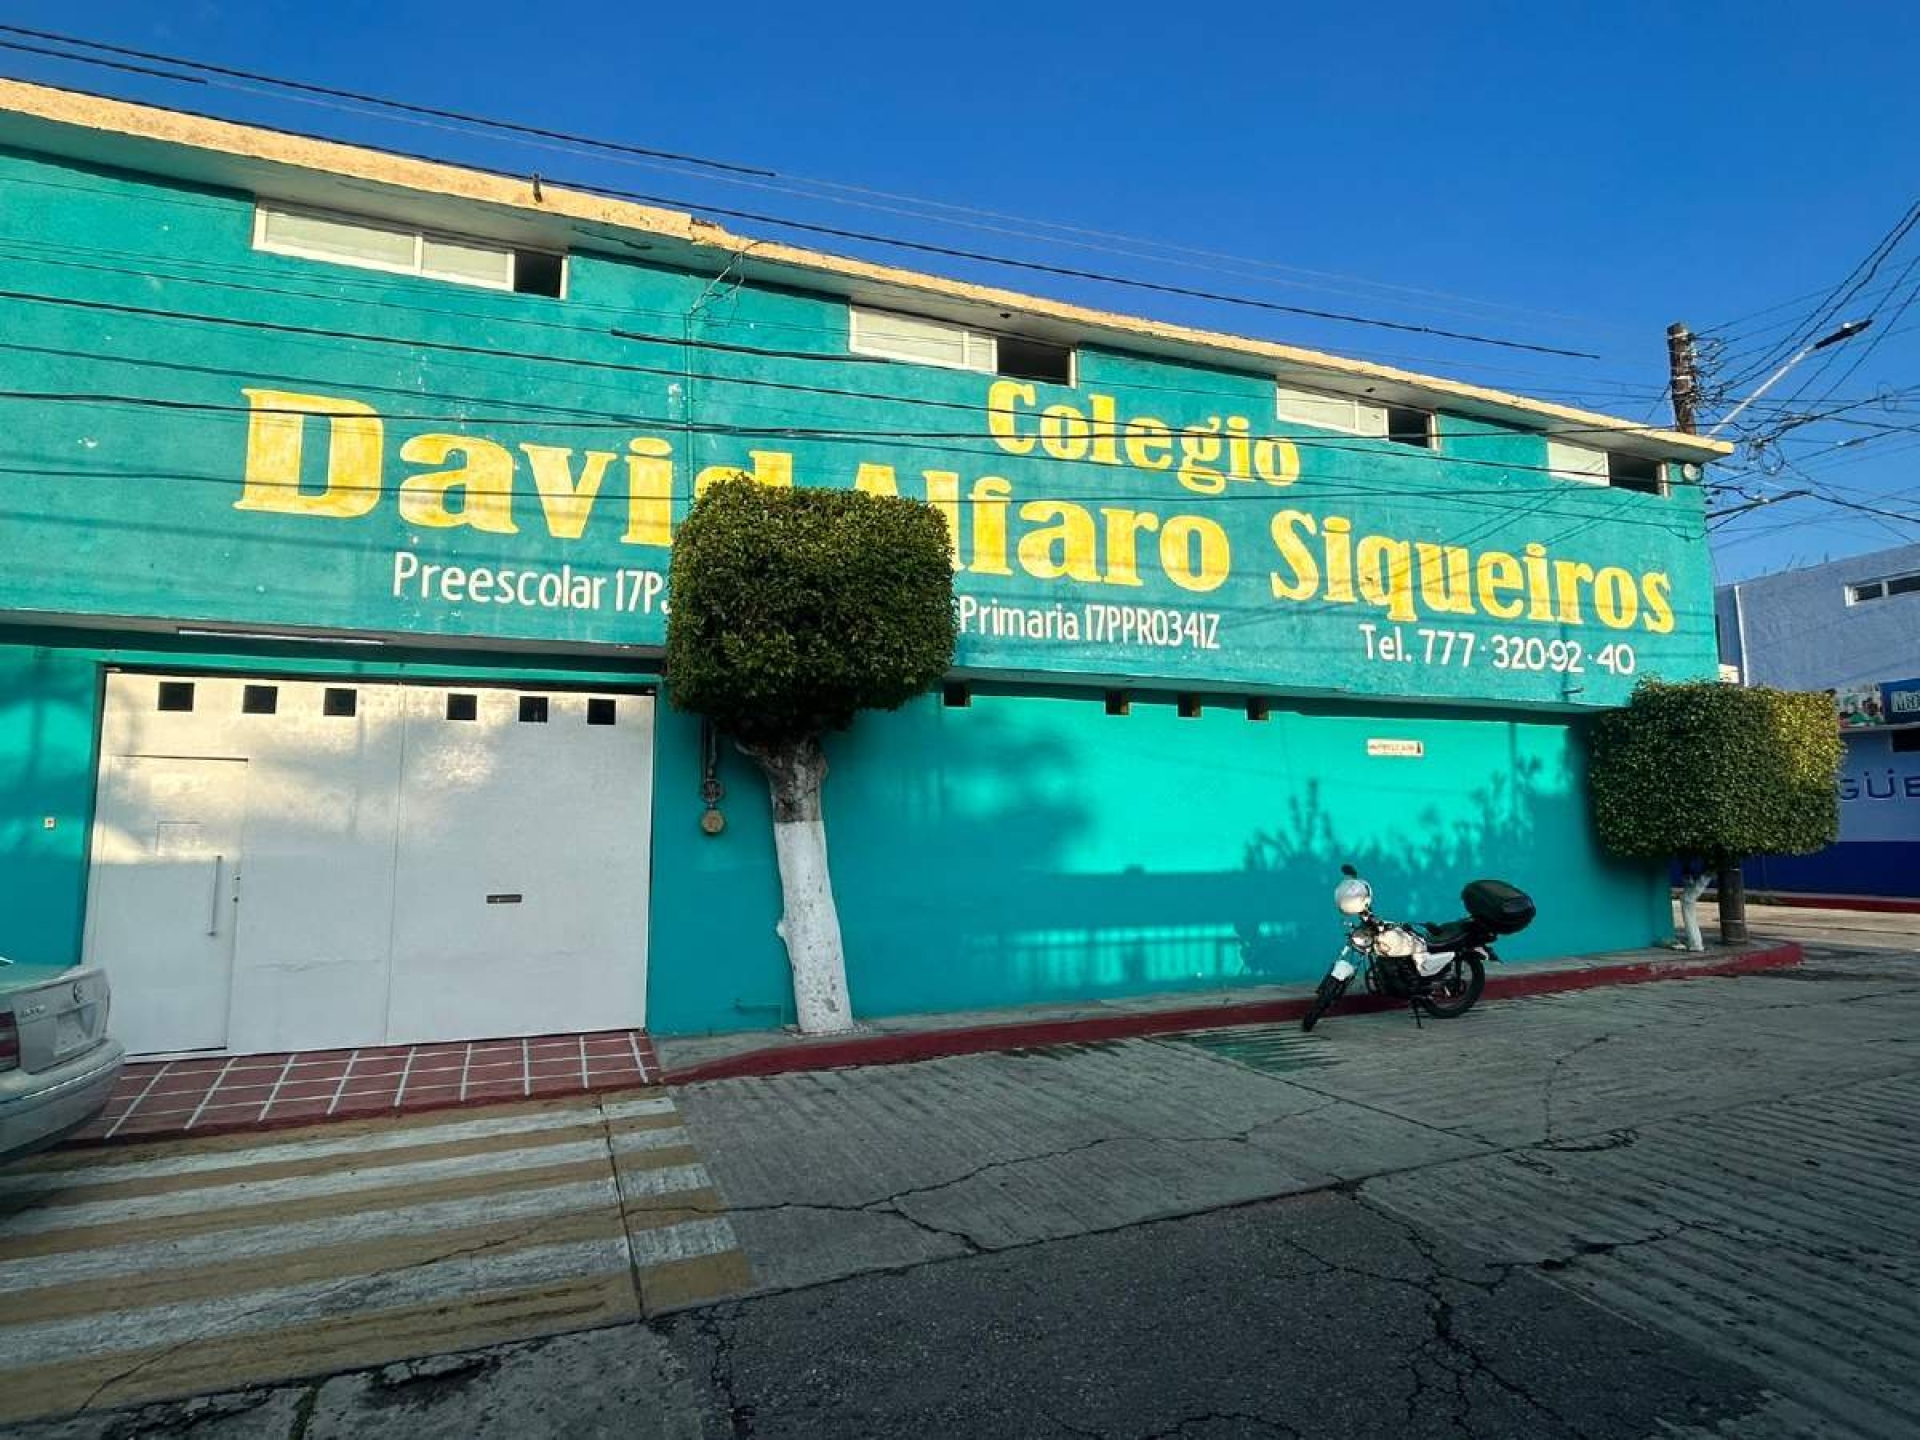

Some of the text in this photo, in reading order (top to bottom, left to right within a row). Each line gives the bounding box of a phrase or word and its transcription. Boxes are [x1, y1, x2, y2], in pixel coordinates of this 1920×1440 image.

[987, 379, 1300, 493] Colegio
[853, 462, 1231, 592] lfaro
[1269, 509, 1676, 634] Siqueiros
[392, 550, 607, 610] Preescolar
[957, 594, 1080, 641] Primaria
[1359, 623, 1412, 662] Tel.
